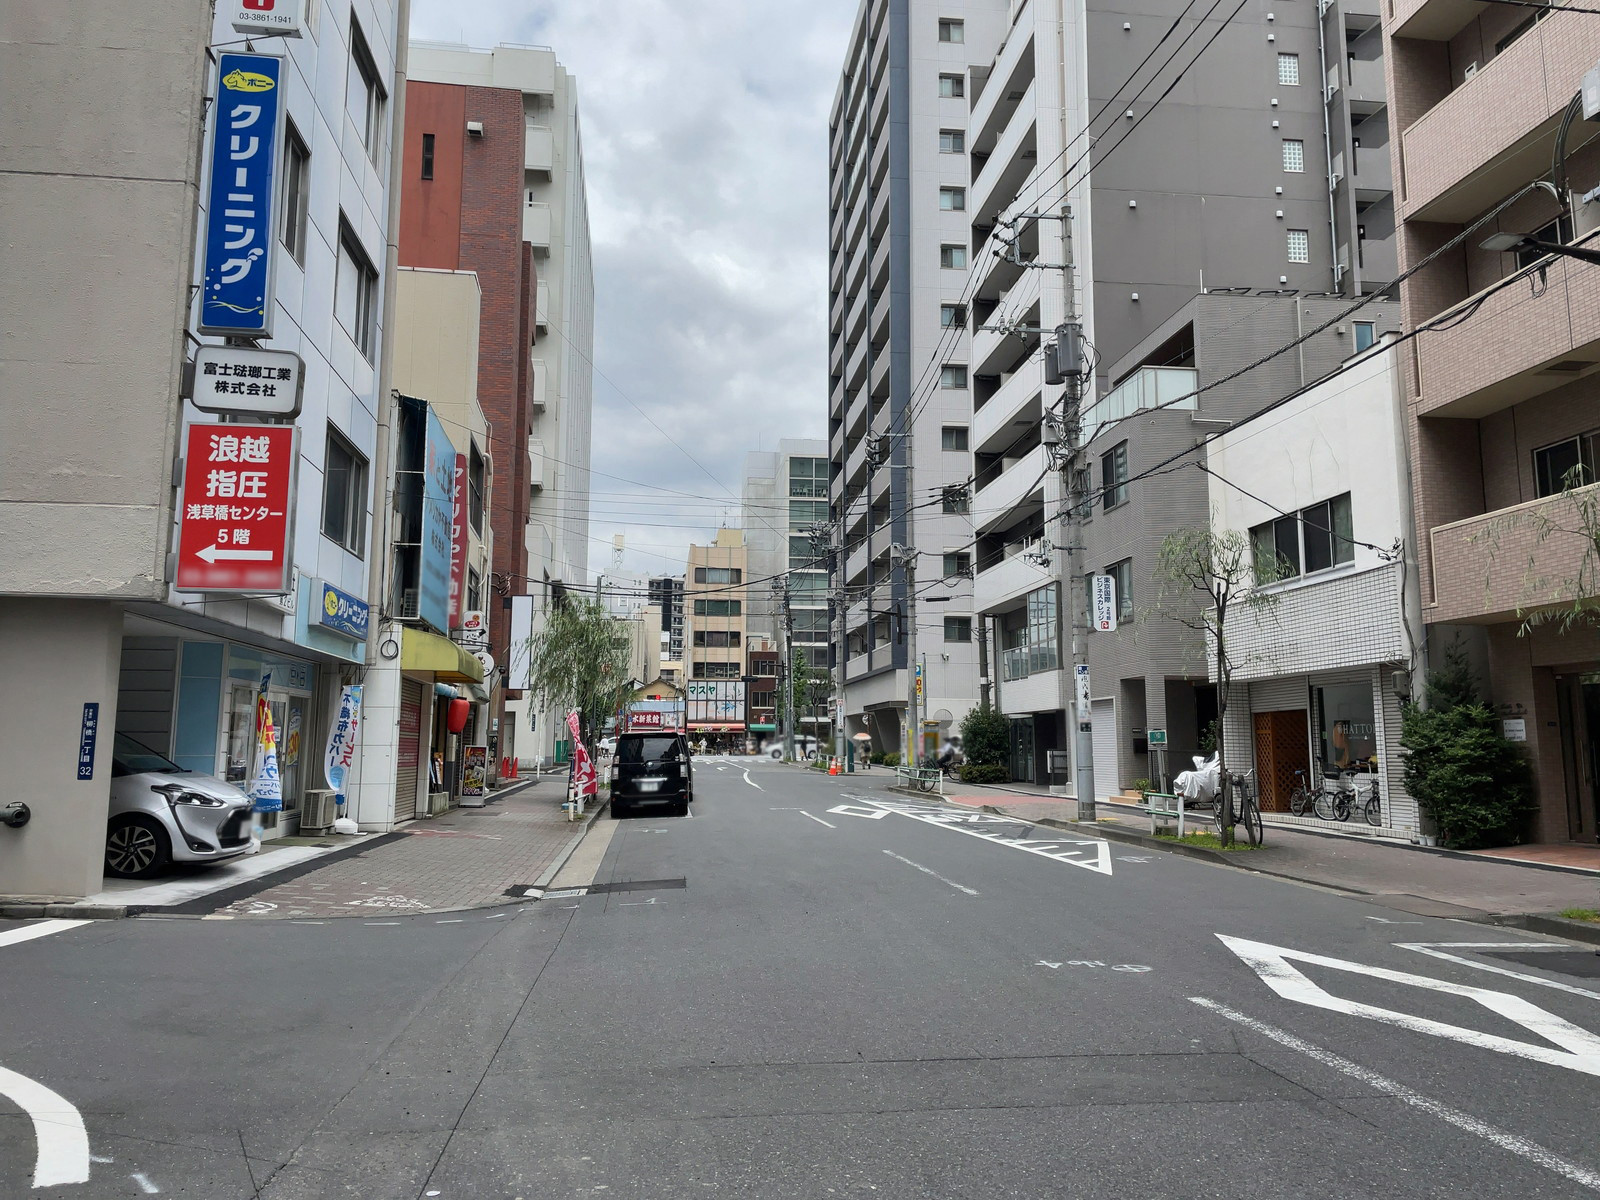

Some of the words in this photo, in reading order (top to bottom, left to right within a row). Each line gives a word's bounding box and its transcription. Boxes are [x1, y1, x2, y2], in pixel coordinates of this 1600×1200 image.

[239, 12, 292, 24] 03-3861-1941
[247, 78, 274, 89] ポニー
[220, 104, 264, 284] クリーニング
[203, 361, 292, 381] 富士琺瑯工業
[214, 380, 277, 397] 株式会社
[208, 434, 271, 464] 浪越
[206, 470, 268, 498] 指圧
[186, 504, 284, 521] 浅草橋センター
[1097, 577, 1105, 621] ビジネスカレッジ
[338, 598, 369, 626] クリーニング
[689, 685, 716, 695] マスヤ
[79, 766, 92, 776] 32
